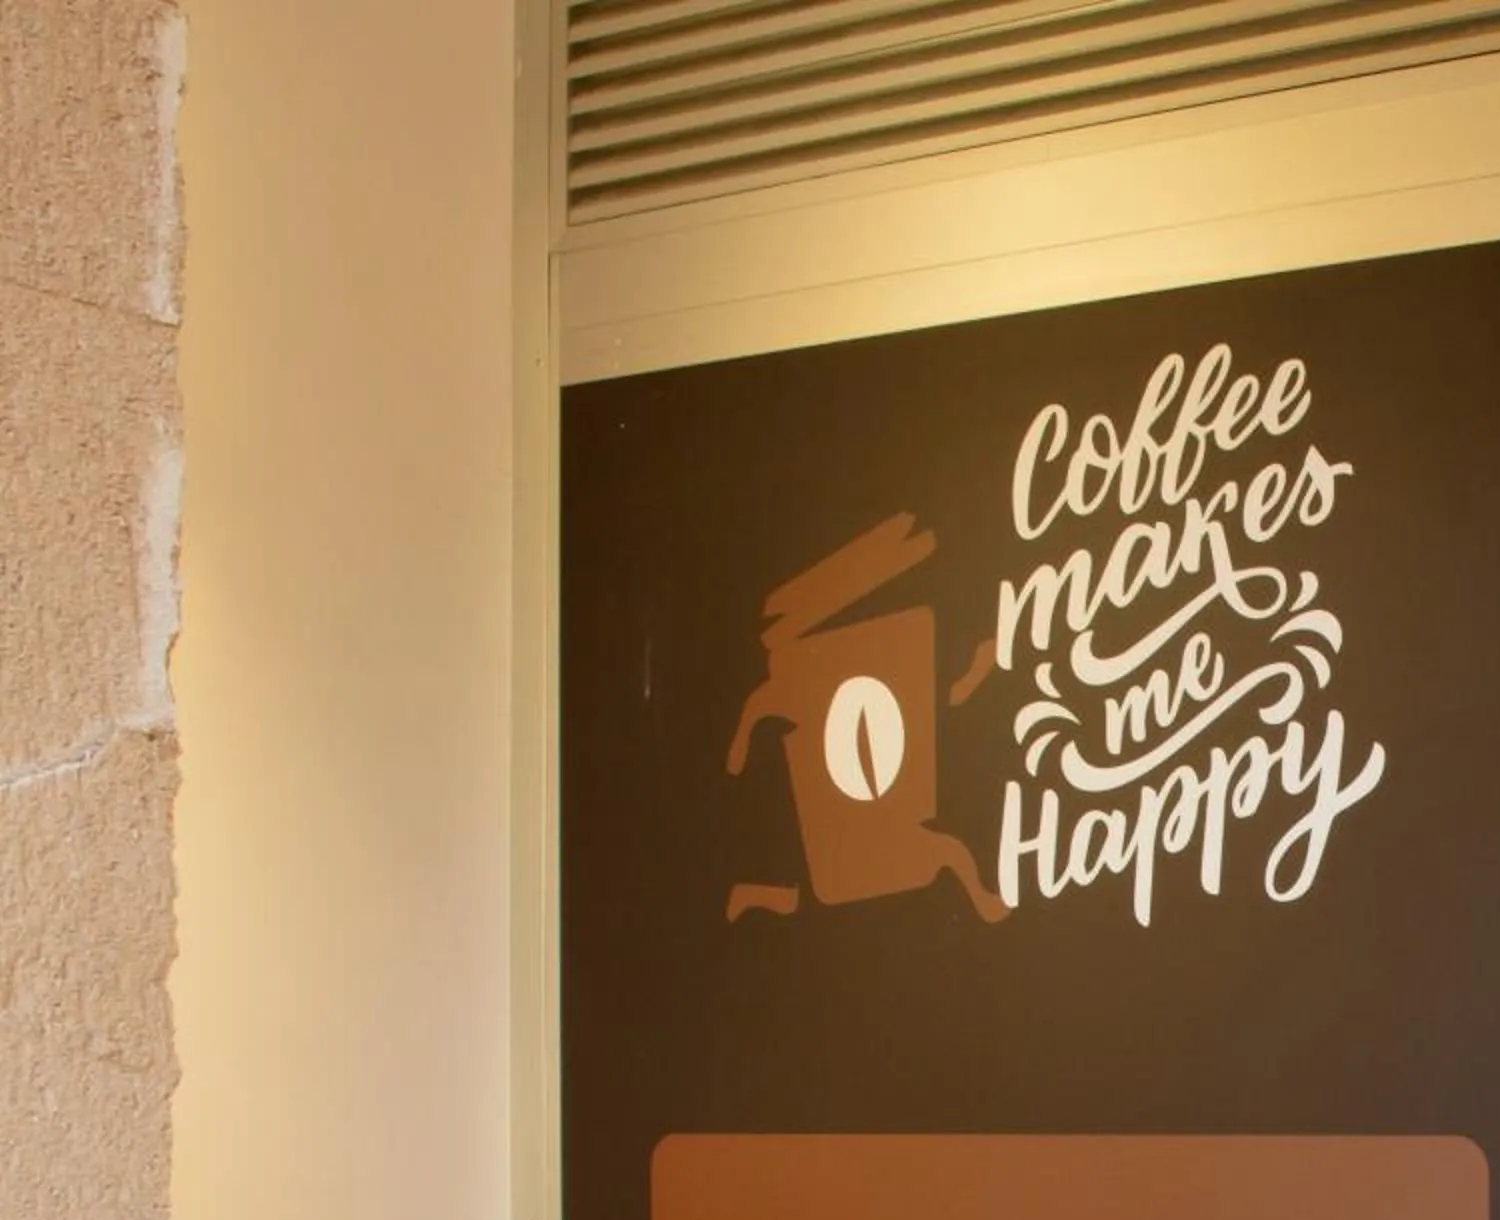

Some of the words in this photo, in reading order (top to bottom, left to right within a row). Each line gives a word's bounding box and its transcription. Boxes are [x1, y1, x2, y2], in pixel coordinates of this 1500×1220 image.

[1012, 343, 1312, 541] Coffee
[996, 444, 1354, 686] makes
[1105, 632, 1225, 756] me
[998, 709, 1387, 929] Happy
